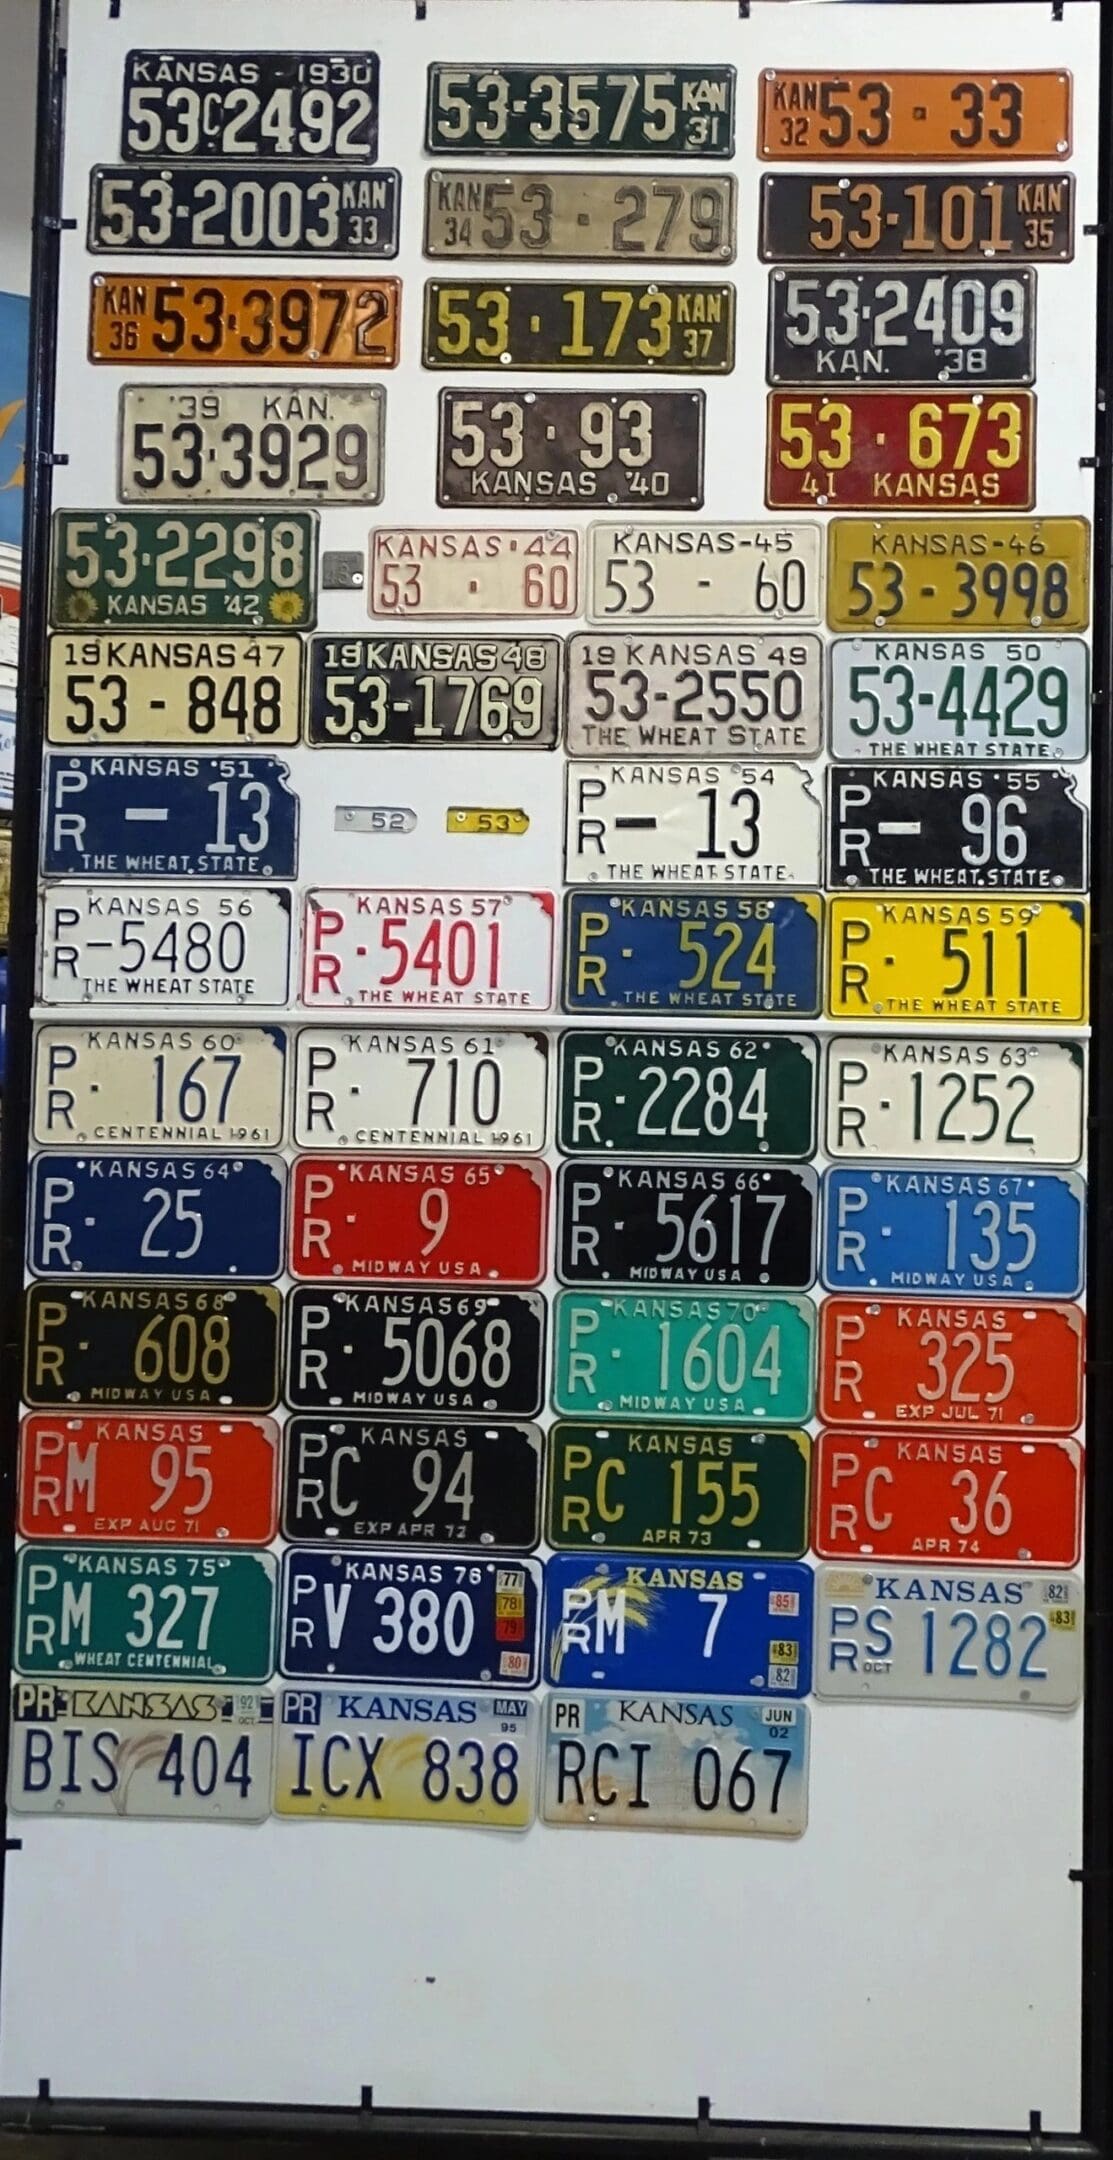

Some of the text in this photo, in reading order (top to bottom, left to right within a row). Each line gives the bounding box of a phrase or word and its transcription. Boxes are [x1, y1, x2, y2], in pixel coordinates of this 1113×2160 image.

[133, 62, 371, 83] KANSAS 1930
[437, 73, 677, 142] 53-3575
[682, 81, 726, 111] KAN
[774, 81, 818, 111] KAN
[689, 117, 718, 144] 31
[780, 117, 809, 146] 32
[343, 181, 386, 209] KAN
[438, 182, 481, 211] KAN
[1017, 183, 1061, 214] KAN
[100, 179, 340, 247] 53-2003
[810, 184, 1014, 251] 53-101
[348, 216, 377, 244] 33
[444, 217, 471, 246] 34
[1025, 220, 1054, 249] 35
[104, 286, 147, 315] KAN
[677, 293, 721, 323] KAN
[786, 279, 1024, 346] 53-2409
[153, 287, 389, 355] 53-3972
[110, 321, 138, 350] 36
[683, 329, 712, 358] 37
[817, 350, 986, 373] KAN. '38
[170, 396, 334, 420] '39 KAN.
[134, 423, 368, 490] 53-3929
[472, 471, 669, 495] KANSAS '40
[801, 473, 1000, 497] 41 KANSAS
[66, 521, 304, 589] 53-2298
[108, 595, 259, 615] KANSAS '42
[65, 643, 284, 667] 19 KANSAS 47
[324, 644, 545, 670] 19 KANSAS 48
[582, 645, 806, 665] 19 KANSAS 49
[876, 643, 1041, 661] KANSAS 50
[325, 676, 543, 736] 53-1769
[587, 670, 802, 721] 53-2550
[850, 665, 1068, 737] 53-4429
[582, 725, 806, 745] THE WHEAT STATE
[870, 743, 1049, 756] THE WHEAT STATE
[90, 759, 254, 778] KANSAS 51
[612, 767, 774, 784] KANSAS 54
[874, 771, 1040, 790] KANSAS 55
[372, 812, 405, 829] 52
[479, 815, 510, 831] 53
[870, 868, 1050, 885] THE WHEAT STATE
[88, 898, 252, 916] KANSAS 56
[680, 922, 776, 991] 524
[943, 928, 1027, 997] 511
[84, 978, 254, 994] THE WHEAT STATE
[359, 990, 530, 1004] THE WHEAT STATE
[153, 1055, 241, 1123] 167
[408, 1057, 501, 1126] 710
[95, 1126, 221, 1139] CENTENNIAL
[946, 1200, 1037, 1272] 135
[352, 1260, 480, 1275] MIDWAY USA
[898, 1308, 1006, 1330] KANSAS
[135, 1314, 230, 1384] 608
[382, 1317, 511, 1388] 5068
[659, 1322, 782, 1395] 1604
[917, 1331, 1015, 1404] 325
[91, 1387, 210, 1401] MIDWAY USA
[896, 1405, 1003, 1420] EXP JUL 71
[97, 1423, 204, 1441] KANSAS
[362, 1427, 468, 1447] KANSAS
[628, 1434, 733, 1456] KANSAS
[898, 1442, 1002, 1465] KANSAS
[94, 1518, 199, 1532] EXP AUG 71
[354, 1522, 466, 1538] EXP APR 72
[642, 1529, 712, 1545] APR 73
[912, 1538, 980, 1553] APR 74
[78, 1556, 216, 1576] KANSAS 75
[346, 1563, 481, 1584] KANSAS 76
[504, 1573, 518, 1587] 77
[625, 1567, 743, 1591] KANSAS
[875, 1577, 1023, 1605] KANSAS
[776, 1595, 789, 1608] 85
[1048, 1584, 1062, 1599] 82
[503, 1598, 517, 1610] 78
[1056, 1611, 1070, 1624] 83
[74, 1652, 213, 1668] WHEAT CENTENNIAL
[778, 1643, 792, 1656] 83
[776, 1668, 789, 1682] 82
[863, 1662, 892, 1673] OCT
[18, 1686, 54, 1718] PR
[72, 1690, 218, 1721] KANSAS
[284, 1692, 317, 1723] PR
[337, 1695, 477, 1724] KANSAS
[495, 1701, 526, 1715] MAY
[620, 1700, 733, 1727] KANSAS
[501, 1723, 516, 1732] 95
[555, 1704, 579, 1728] PR
[766, 1709, 792, 1722] JUN
[769, 1728, 788, 1738] 02
[23, 1729, 251, 1798] BIS 404
[291, 1733, 518, 1806] ICX 838
[558, 1739, 792, 1813] RCI 067
